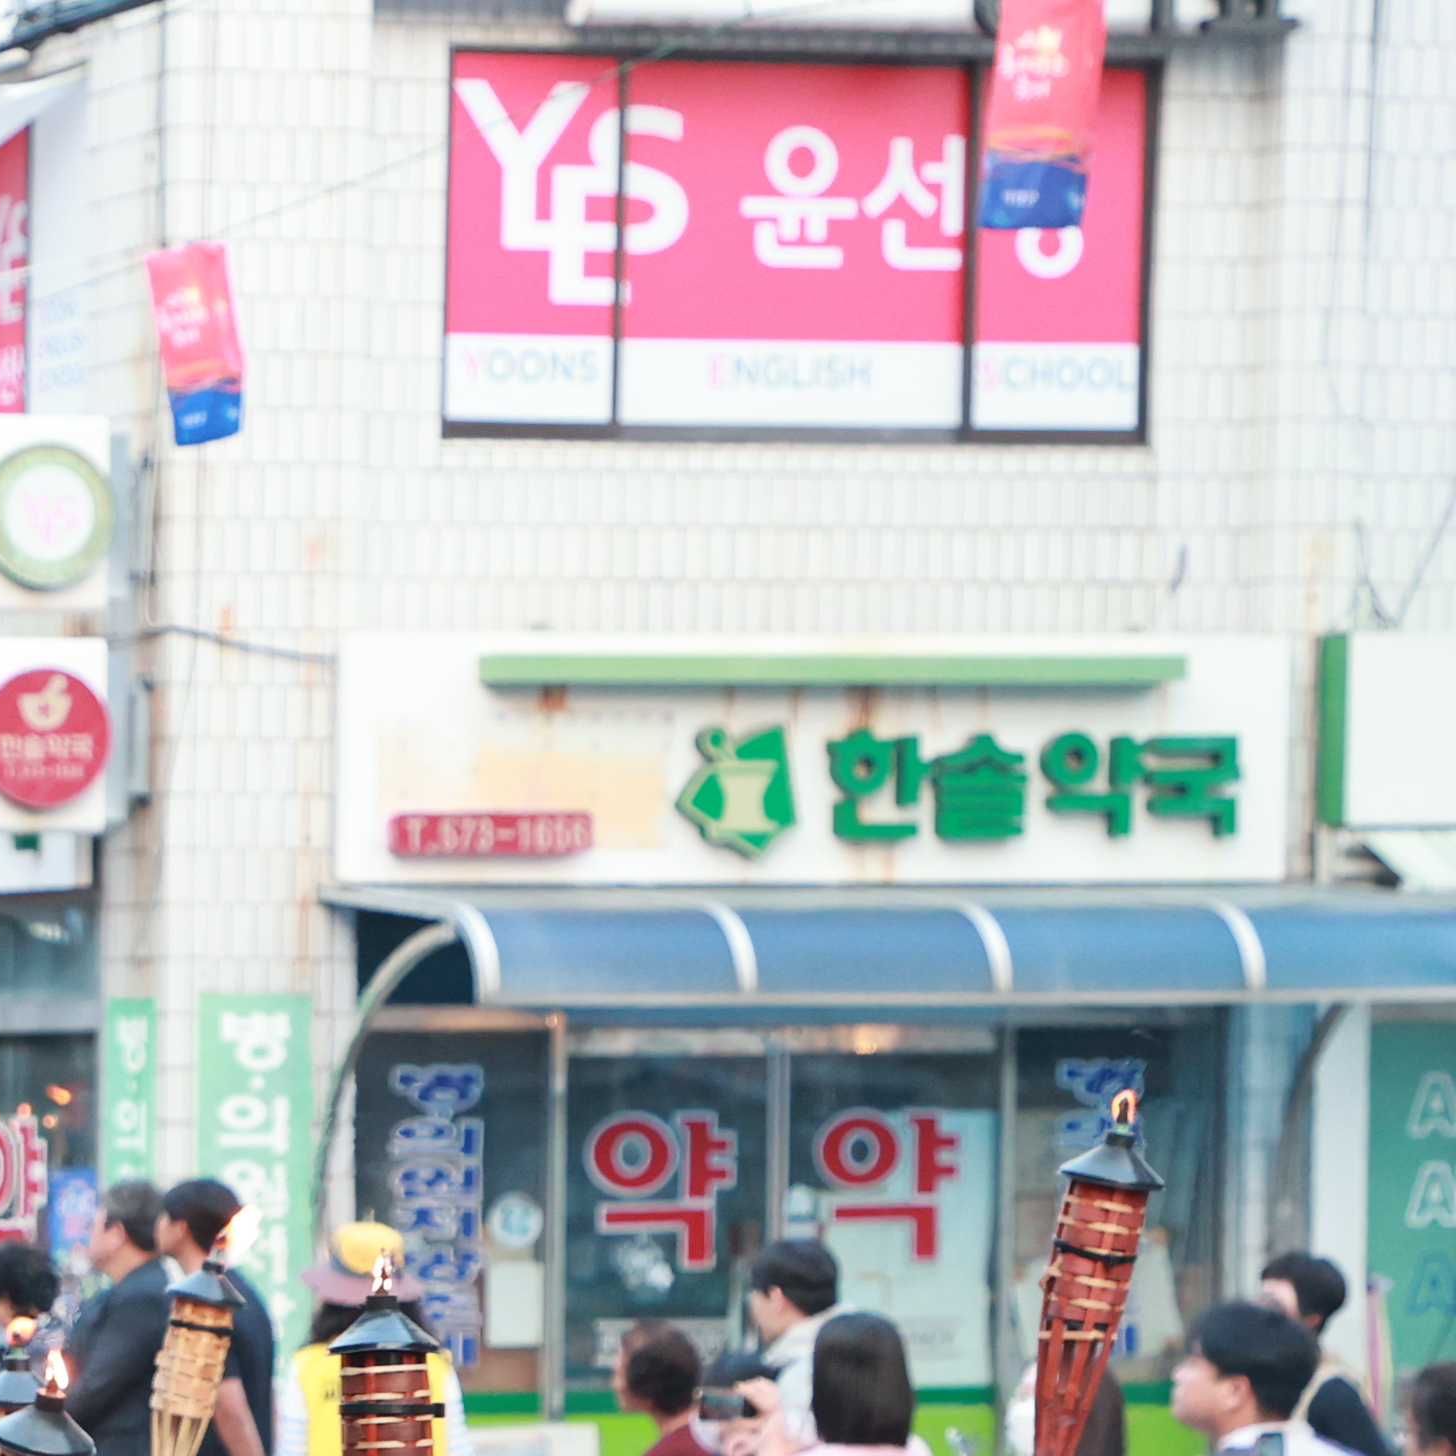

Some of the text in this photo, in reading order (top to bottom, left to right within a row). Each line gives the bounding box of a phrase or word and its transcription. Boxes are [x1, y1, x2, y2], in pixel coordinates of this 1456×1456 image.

[740, 125, 1088, 279] 윤선
[461, 349, 600, 384] YOONS
[707, 353, 873, 391] ENGLISH
[979, 353, 1136, 393] SCHOOL
[827, 727, 1241, 844] 한솔약국
[588, 1113, 738, 1269] 약
[818, 1112, 960, 1264] 약
